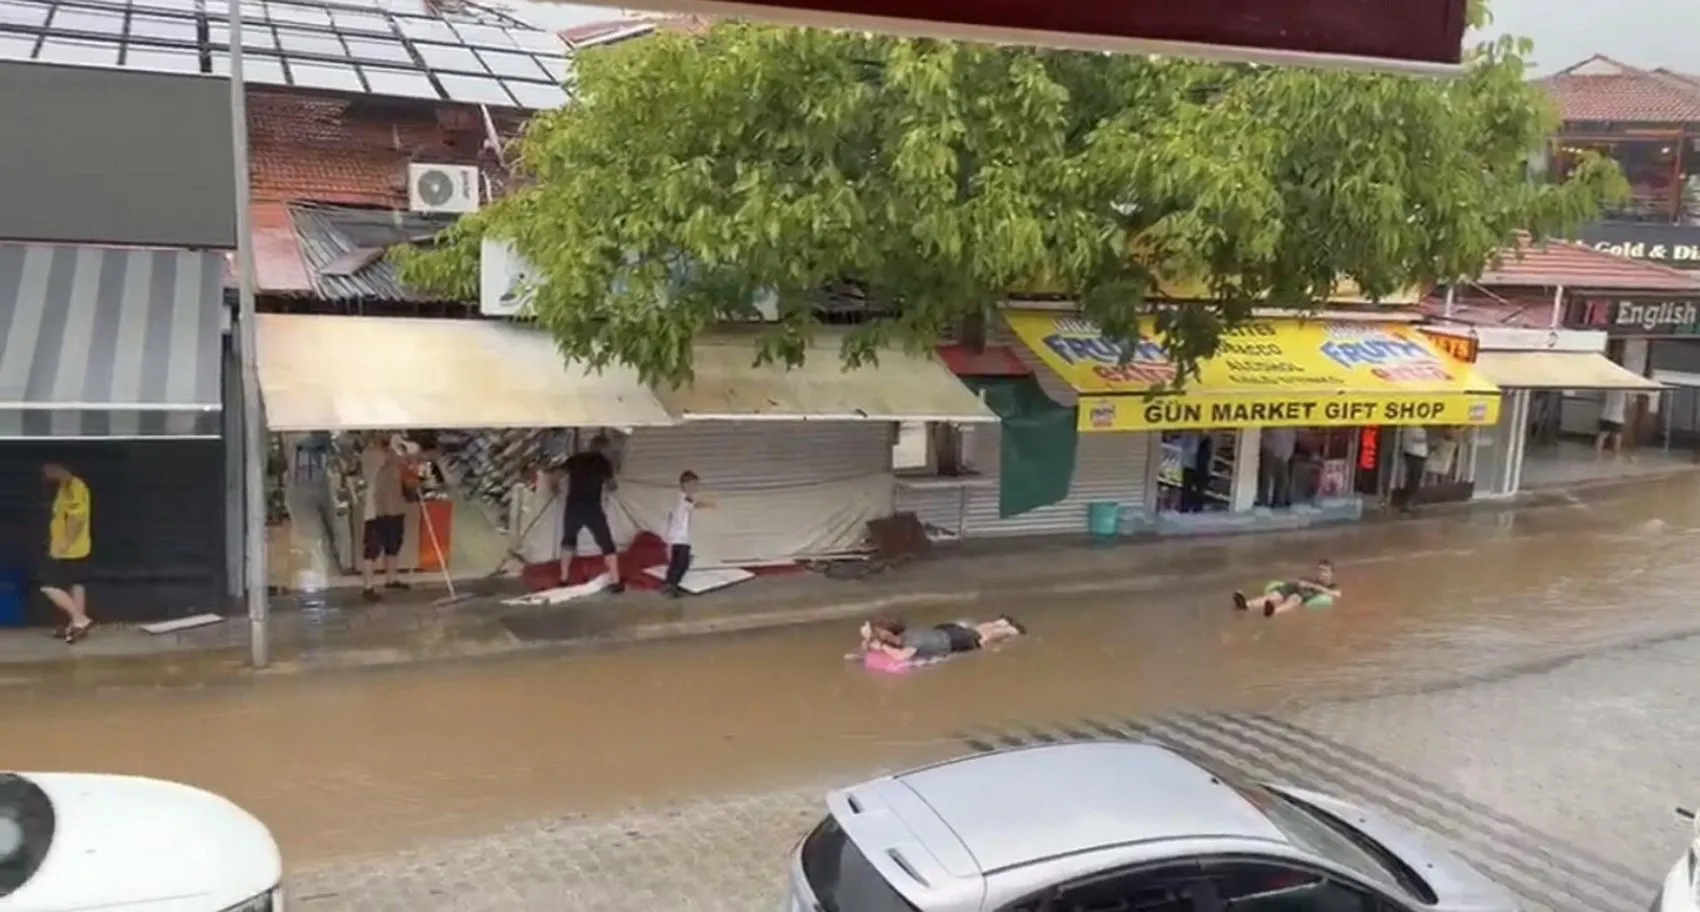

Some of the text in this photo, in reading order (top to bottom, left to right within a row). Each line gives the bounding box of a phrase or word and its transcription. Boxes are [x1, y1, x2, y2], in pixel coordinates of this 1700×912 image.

[1648, 244, 1668, 259] &
[1616, 301, 1697, 330] English
[1144, 400, 1202, 424] GÜN
[1211, 402, 1316, 422] MARKET
[1325, 402, 1378, 420] GIFT
[1384, 402, 1445, 419] SHOP
